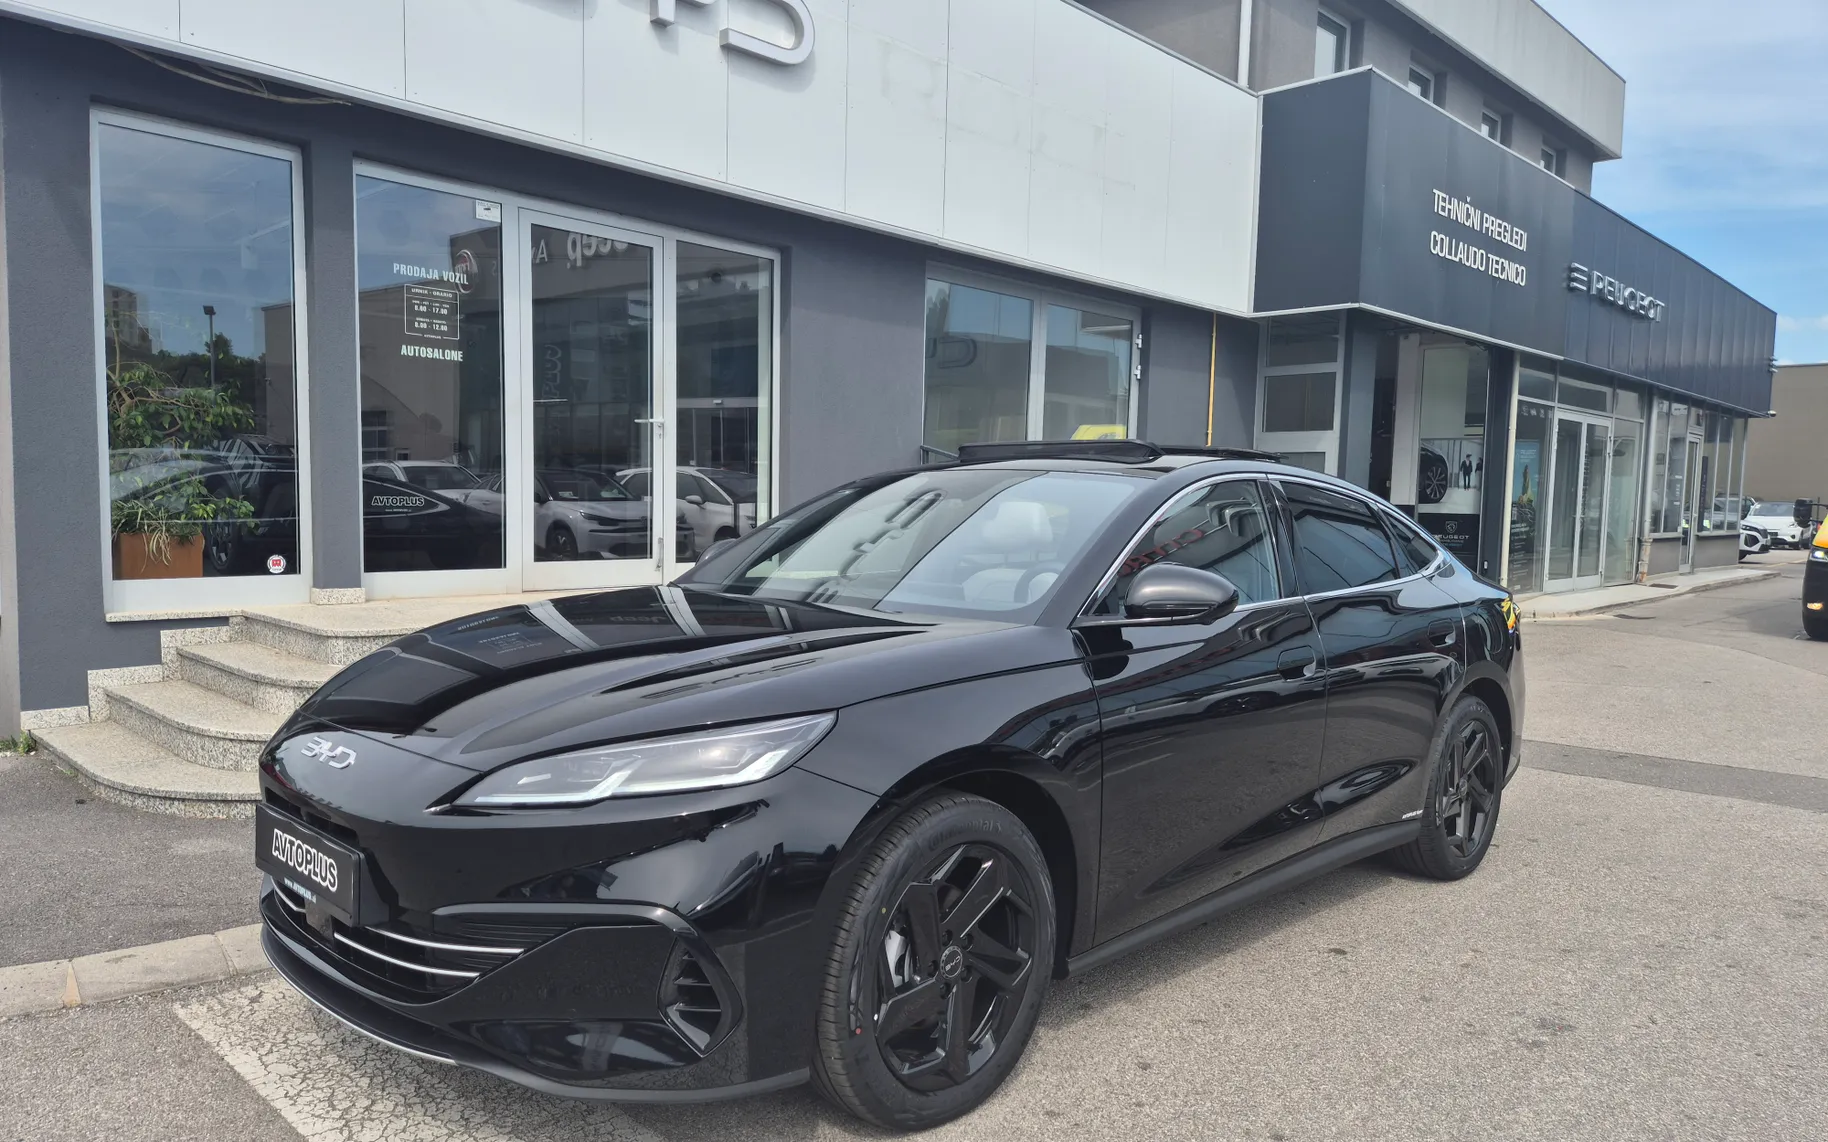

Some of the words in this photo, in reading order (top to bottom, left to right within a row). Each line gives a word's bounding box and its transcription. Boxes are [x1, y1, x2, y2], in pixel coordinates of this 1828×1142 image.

[1433, 189, 1480, 232] TEHNIČNI
[1483, 213, 1527, 252] PREGLEDI
[393, 263, 439, 280] PRODAJA
[442, 270, 469, 285] VOZIL
[1430, 230, 1485, 272] COLLAUDO
[1488, 253, 1526, 287] TECNICO
[1590, 270, 1665, 322] PEUGEOT
[401, 345, 463, 361] AUTOSALONE
[372, 496, 424, 506] AVTOPLUS
[300, 736, 357, 769] BYD
[272, 828, 338, 892] AVTOPLUS
